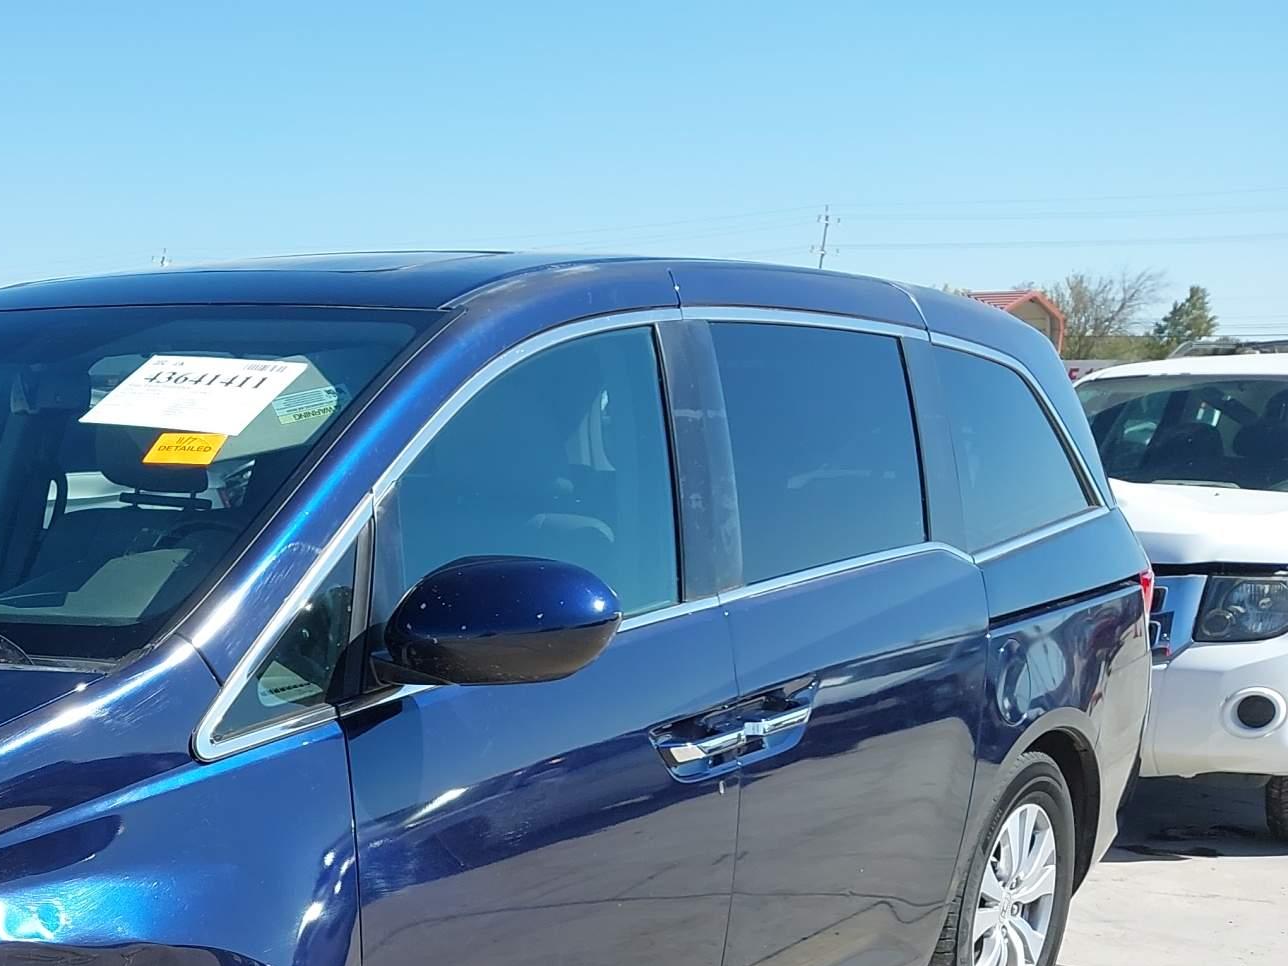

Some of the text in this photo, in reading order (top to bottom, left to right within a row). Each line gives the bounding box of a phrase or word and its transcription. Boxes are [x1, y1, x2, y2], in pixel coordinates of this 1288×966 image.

[144, 371, 268, 389] 43641411
[293, 406, 334, 420] WARNING
[157, 445, 213, 453] DETAILED
